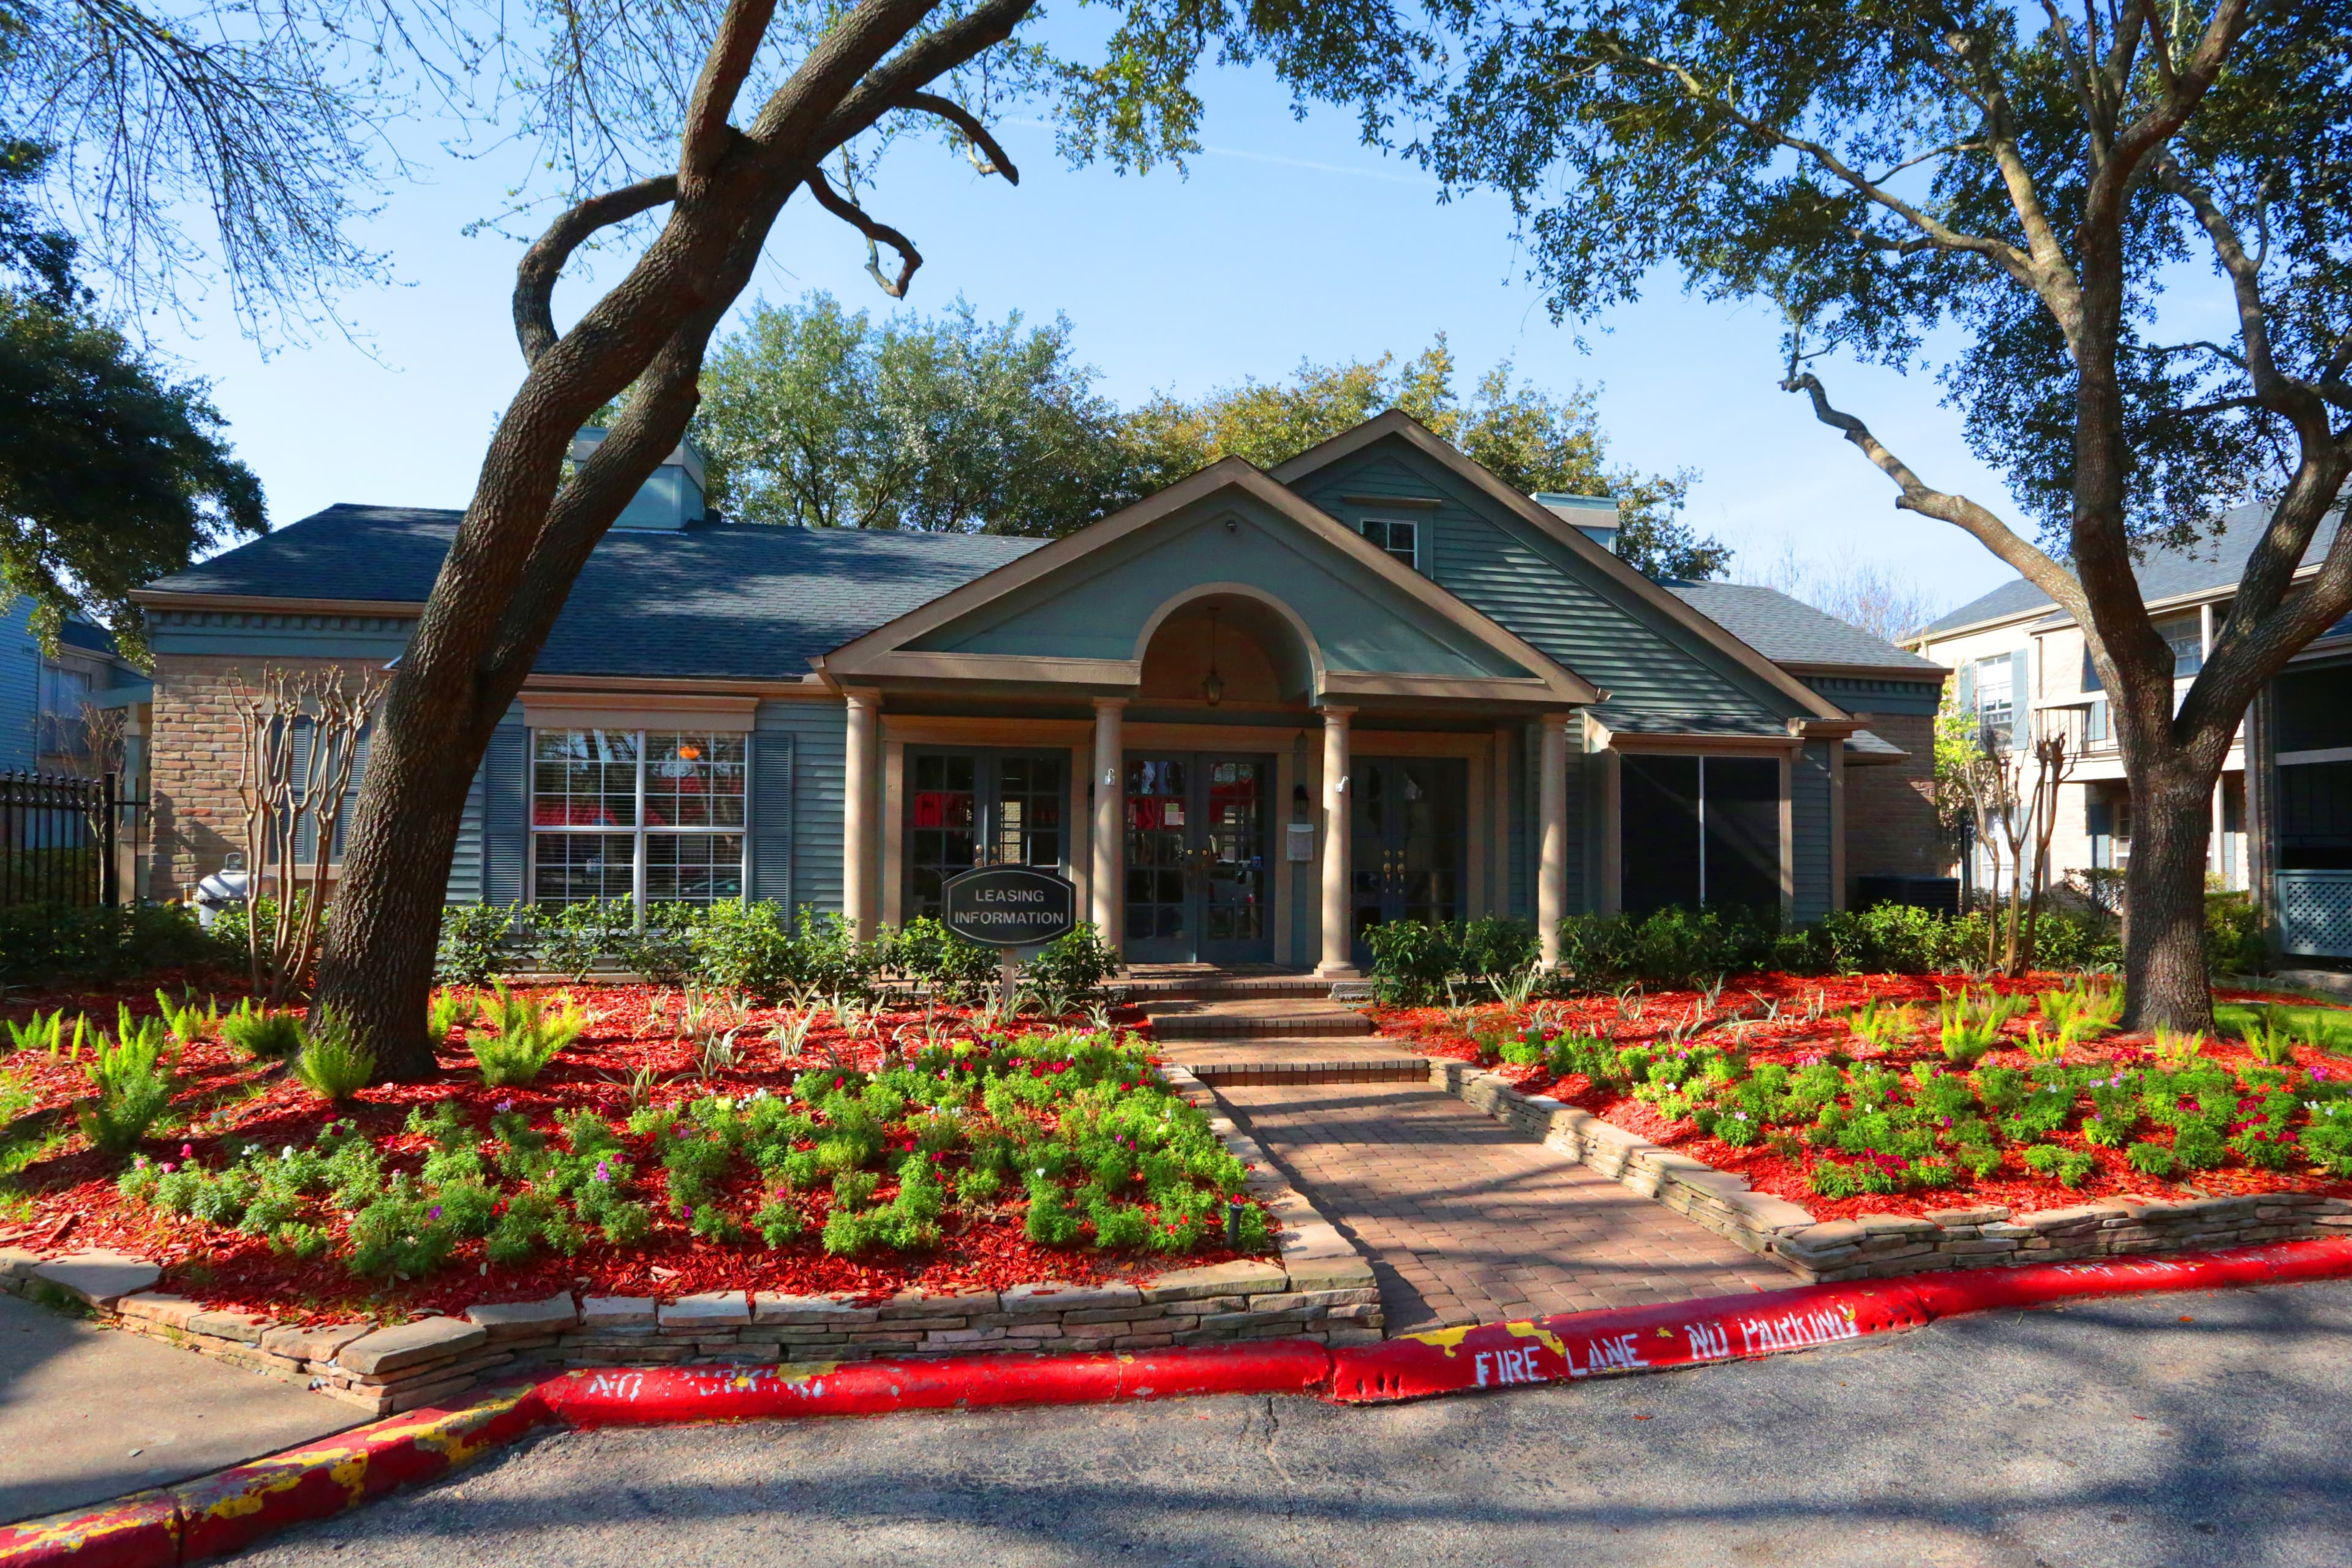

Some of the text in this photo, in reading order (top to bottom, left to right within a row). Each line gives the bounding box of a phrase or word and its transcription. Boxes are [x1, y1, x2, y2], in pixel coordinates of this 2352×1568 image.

[976, 889, 1044, 902] LEASING
[955, 911, 1063, 924] INFORMATION
[1474, 1304, 1860, 1387] FIRE LANE NO PARKING
